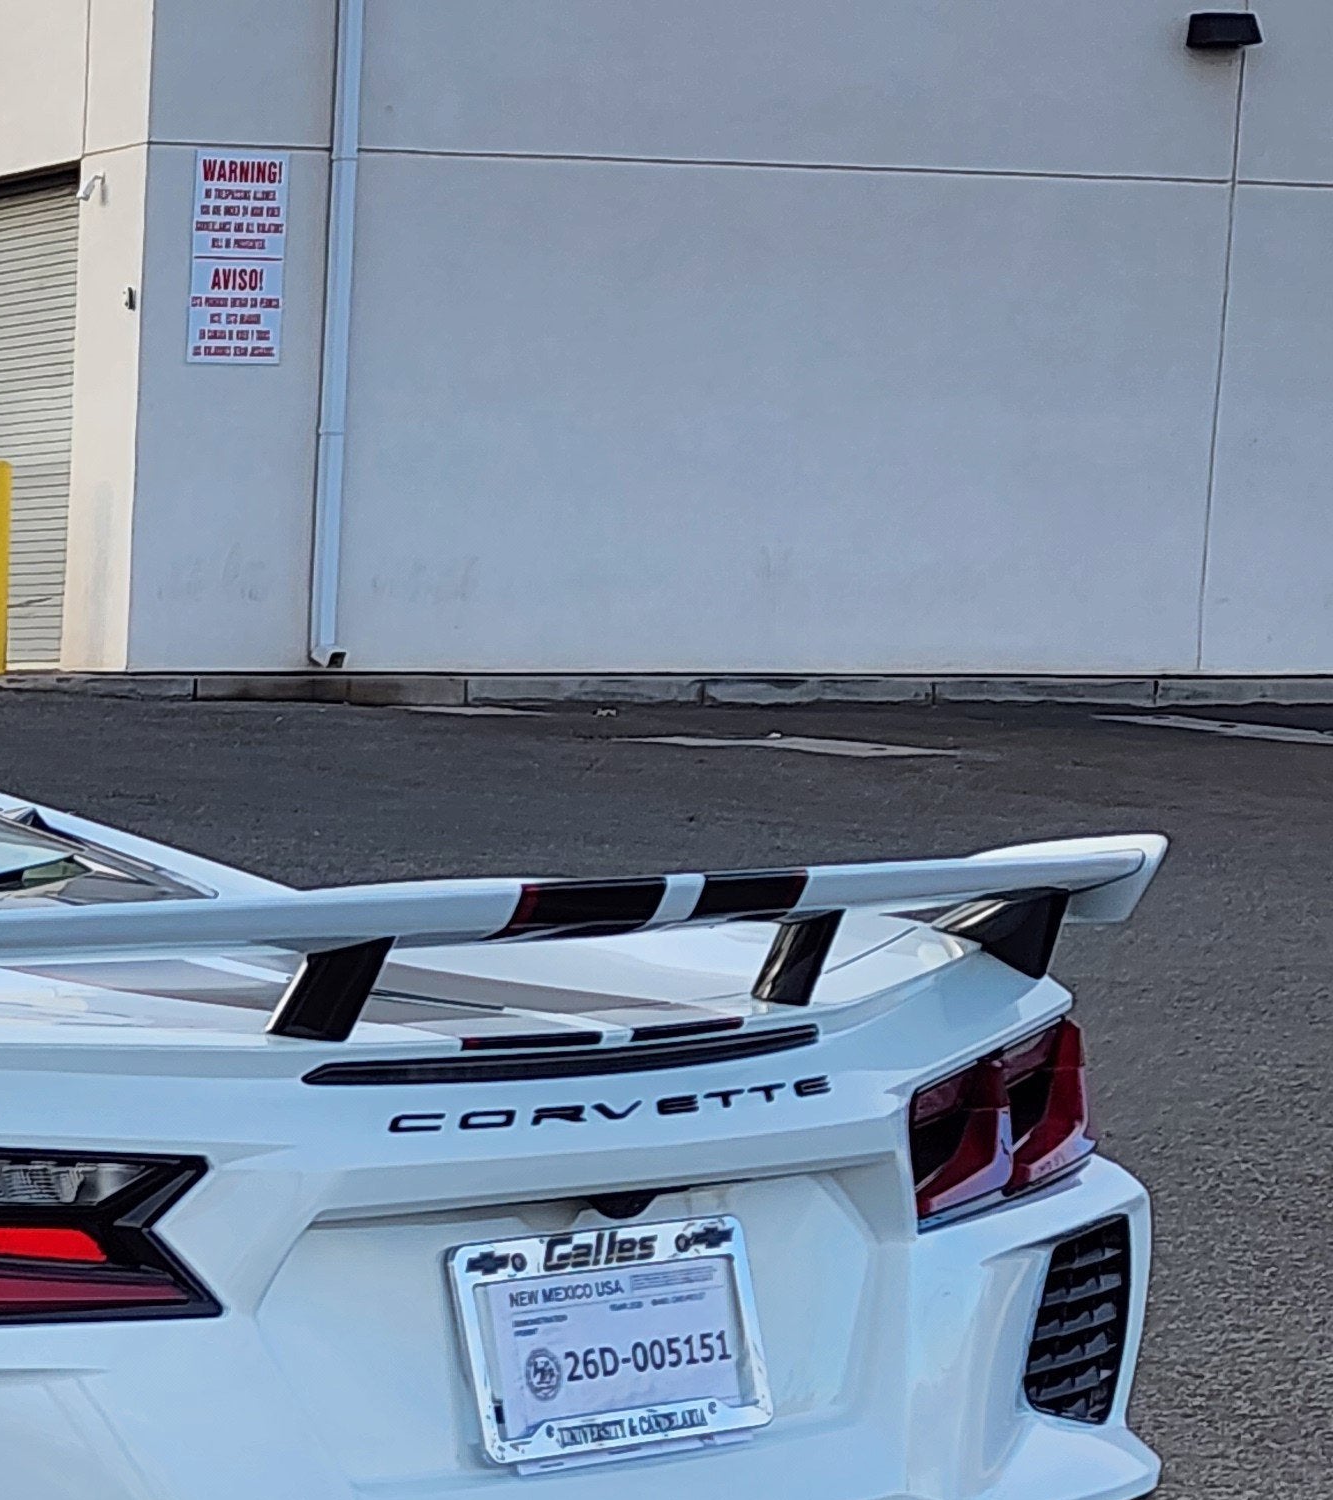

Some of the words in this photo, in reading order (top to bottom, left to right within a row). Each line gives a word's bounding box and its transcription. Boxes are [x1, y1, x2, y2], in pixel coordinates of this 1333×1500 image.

[202, 158, 283, 184] WARNING!
[210, 267, 264, 291] AVISO!
[387, 1074, 832, 1133] CORVETTE
[543, 1230, 659, 1272] Galles
[508, 1290, 539, 1308] NEW
[541, 1282, 594, 1303] MEXICO
[595, 1279, 625, 1298] USA
[564, 1329, 732, 1382] 26D-005151
[628, 1416, 639, 1438] &
